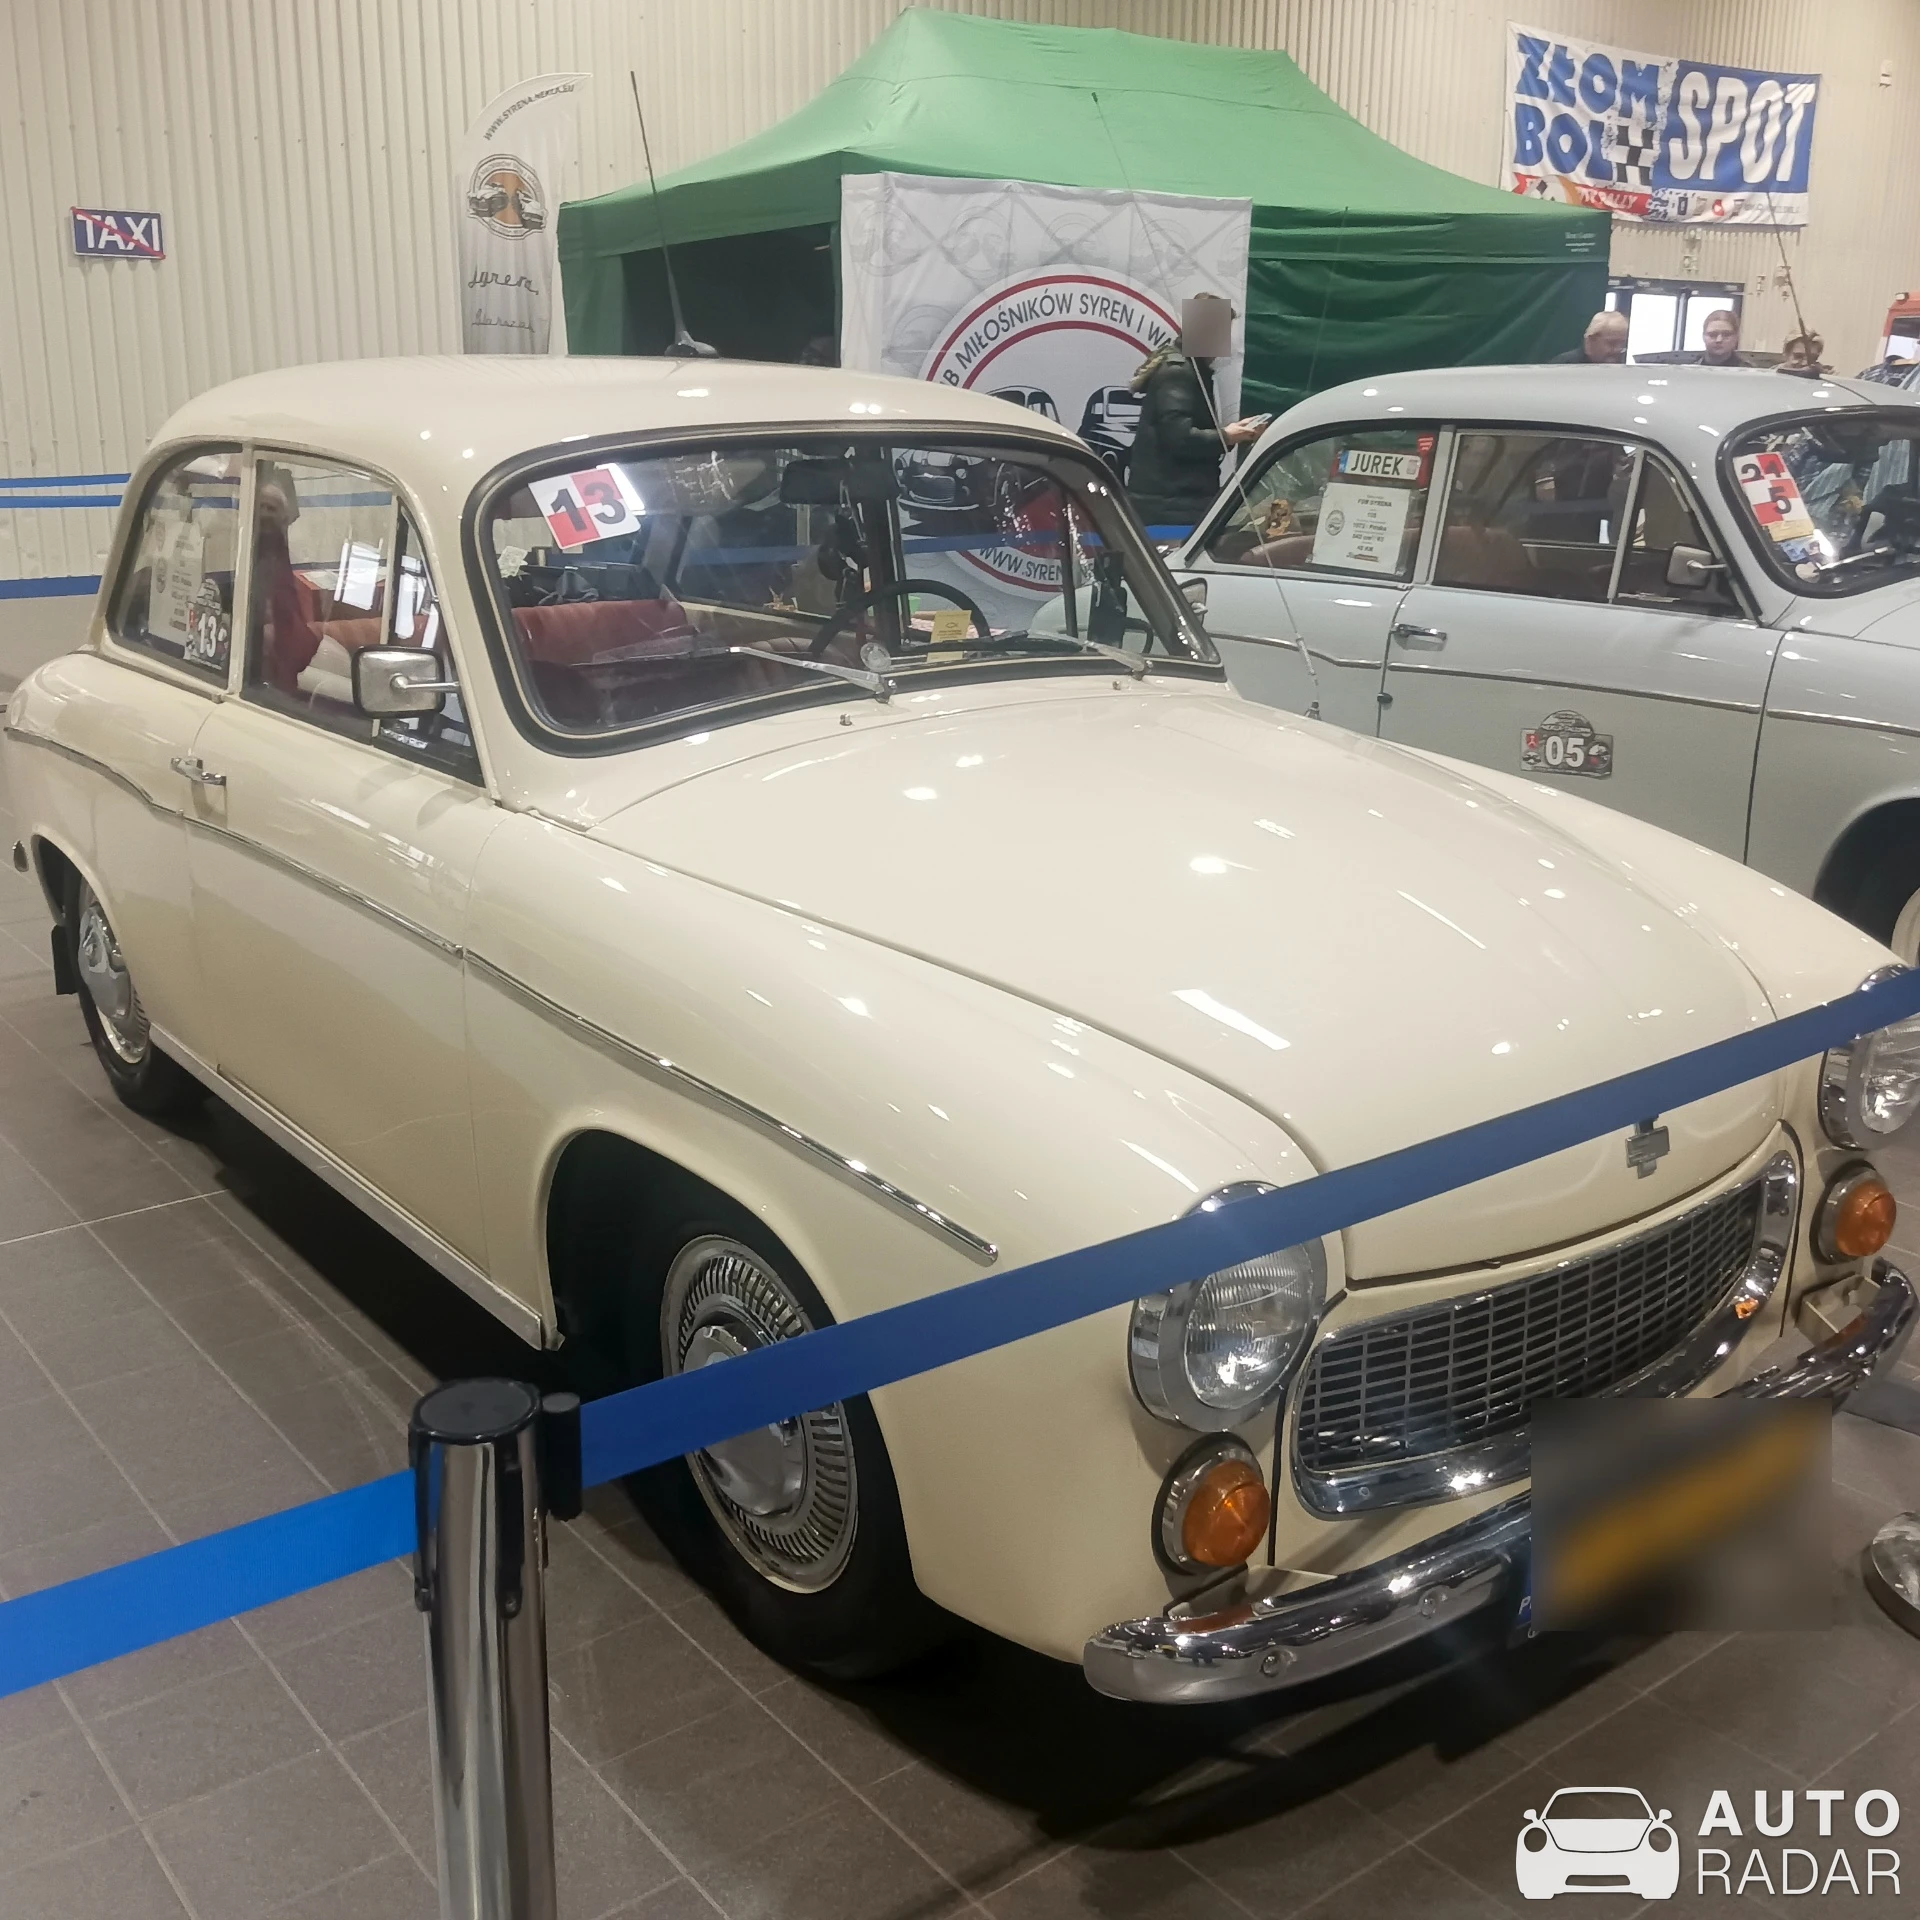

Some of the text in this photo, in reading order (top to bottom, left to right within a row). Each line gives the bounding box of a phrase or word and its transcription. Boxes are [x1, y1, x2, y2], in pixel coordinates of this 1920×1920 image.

[1514, 33, 1660, 124] ZŁOM
[1513, 102, 1614, 181] BOL
[1669, 71, 1816, 184] SPOT
[76, 214, 160, 251] TAXI
[955, 288, 1074, 370] MIŁOŚNIKÓW
[1079, 292, 1136, 325] SYREN
[1136, 314, 1145, 333] I
[1350, 453, 1404, 476] JUREK
[551, 482, 626, 532] 13
[1768, 486, 1792, 514] 5
[198, 612, 217, 658] 13
[1545, 735, 1585, 767] 05
